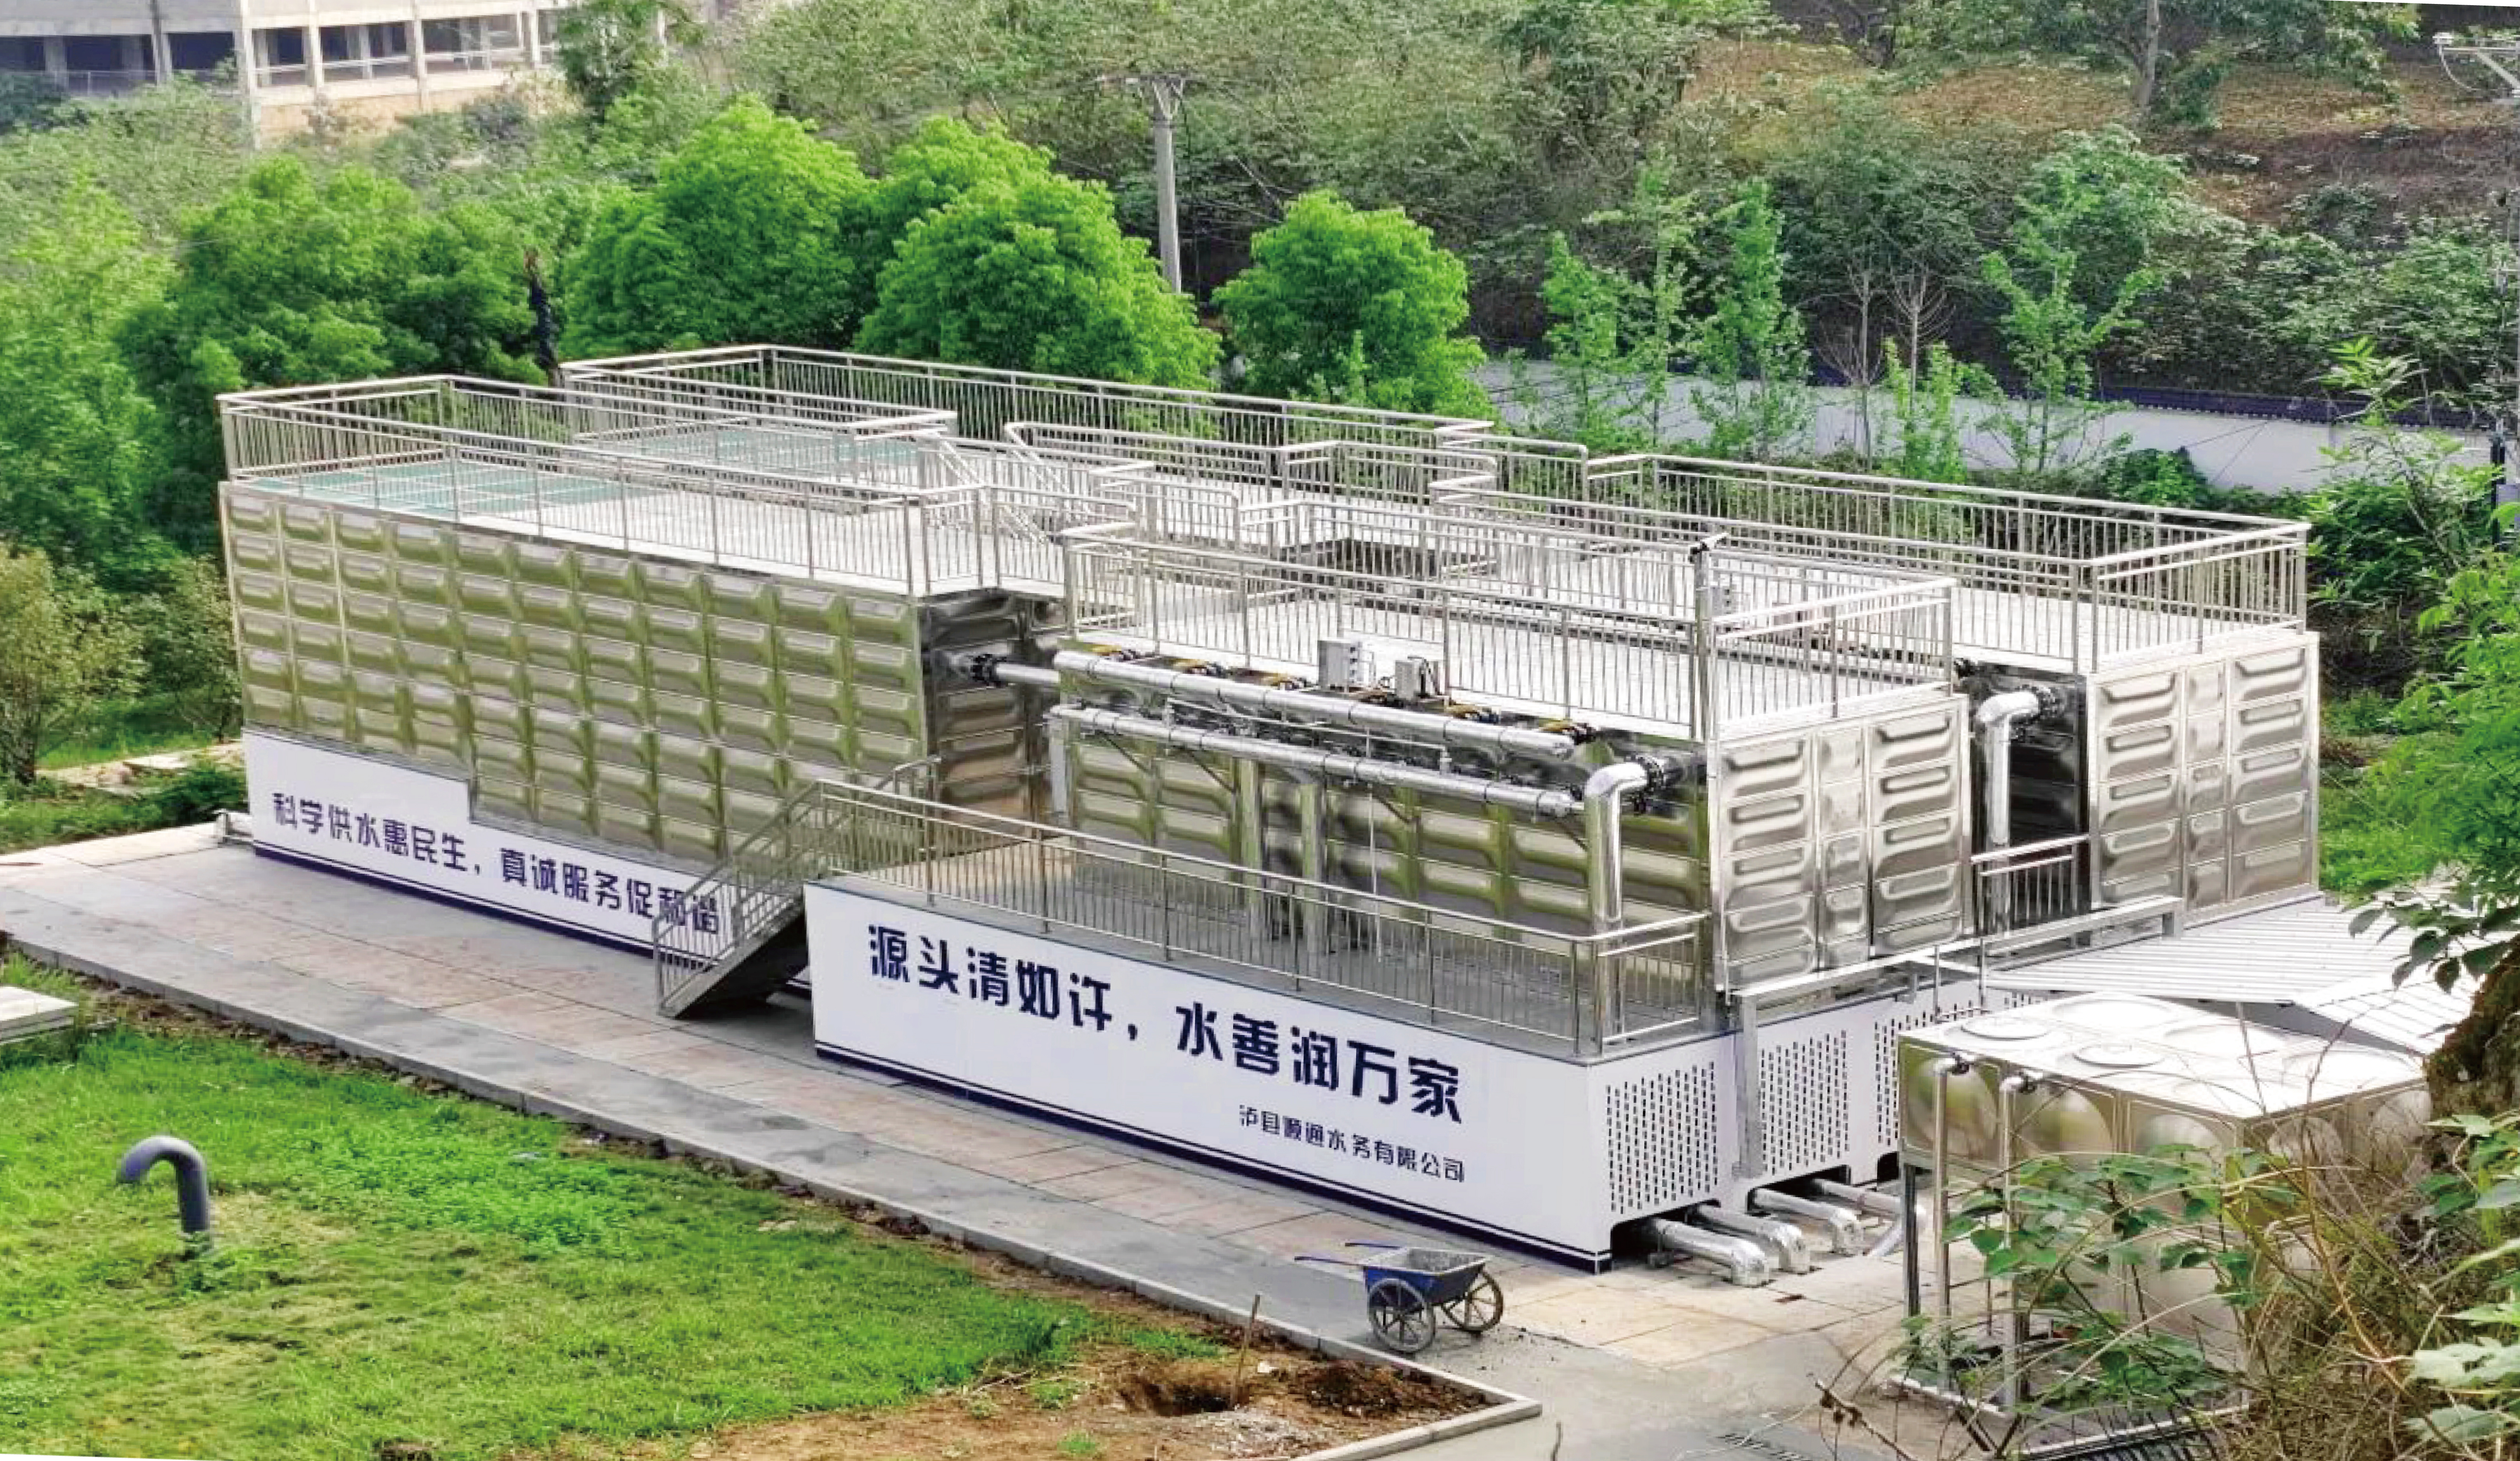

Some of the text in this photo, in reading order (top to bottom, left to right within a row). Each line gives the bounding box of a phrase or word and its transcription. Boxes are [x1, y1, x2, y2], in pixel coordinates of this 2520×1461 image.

[868, 925, 1461, 1124] 源头清如许，水善润万家
